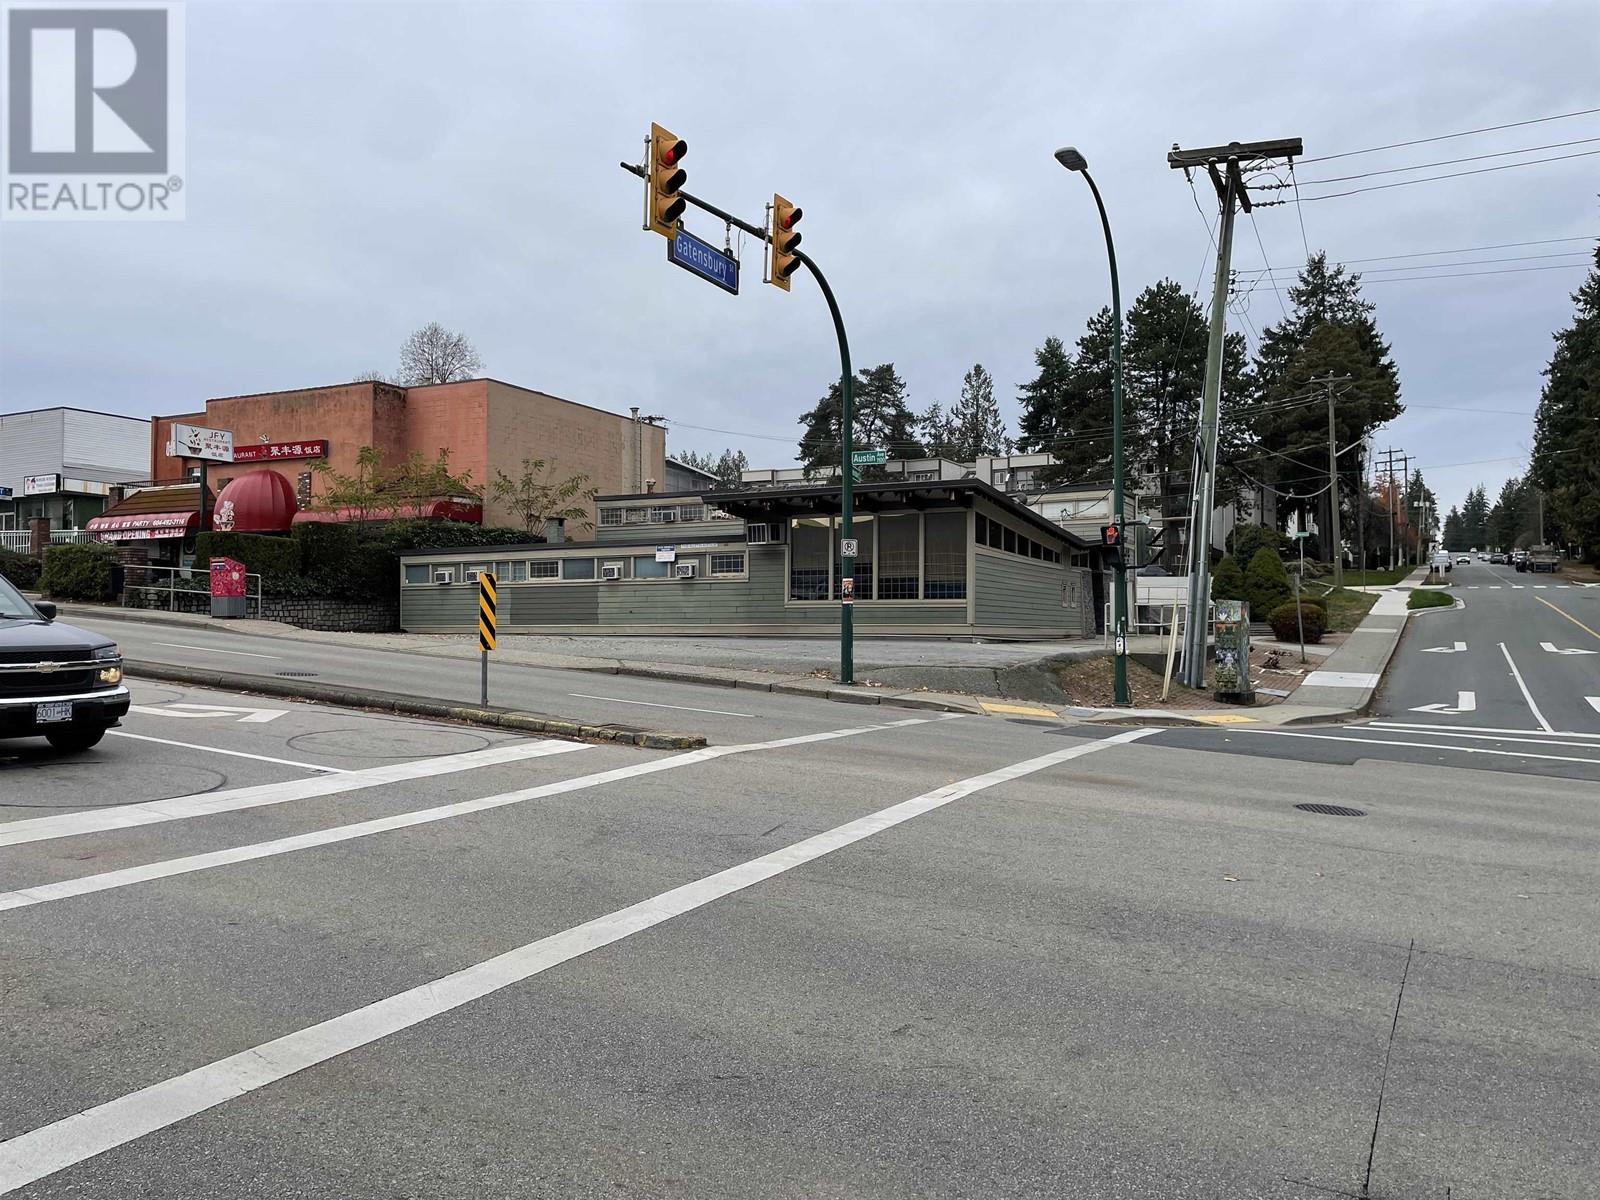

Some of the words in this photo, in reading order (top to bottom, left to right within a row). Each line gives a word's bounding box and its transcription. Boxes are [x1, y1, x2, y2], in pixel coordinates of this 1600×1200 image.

[676, 235, 727, 281] Gatensbury
[853, 454, 876, 463] Austin
[132, 520, 149, 528] PARTY
